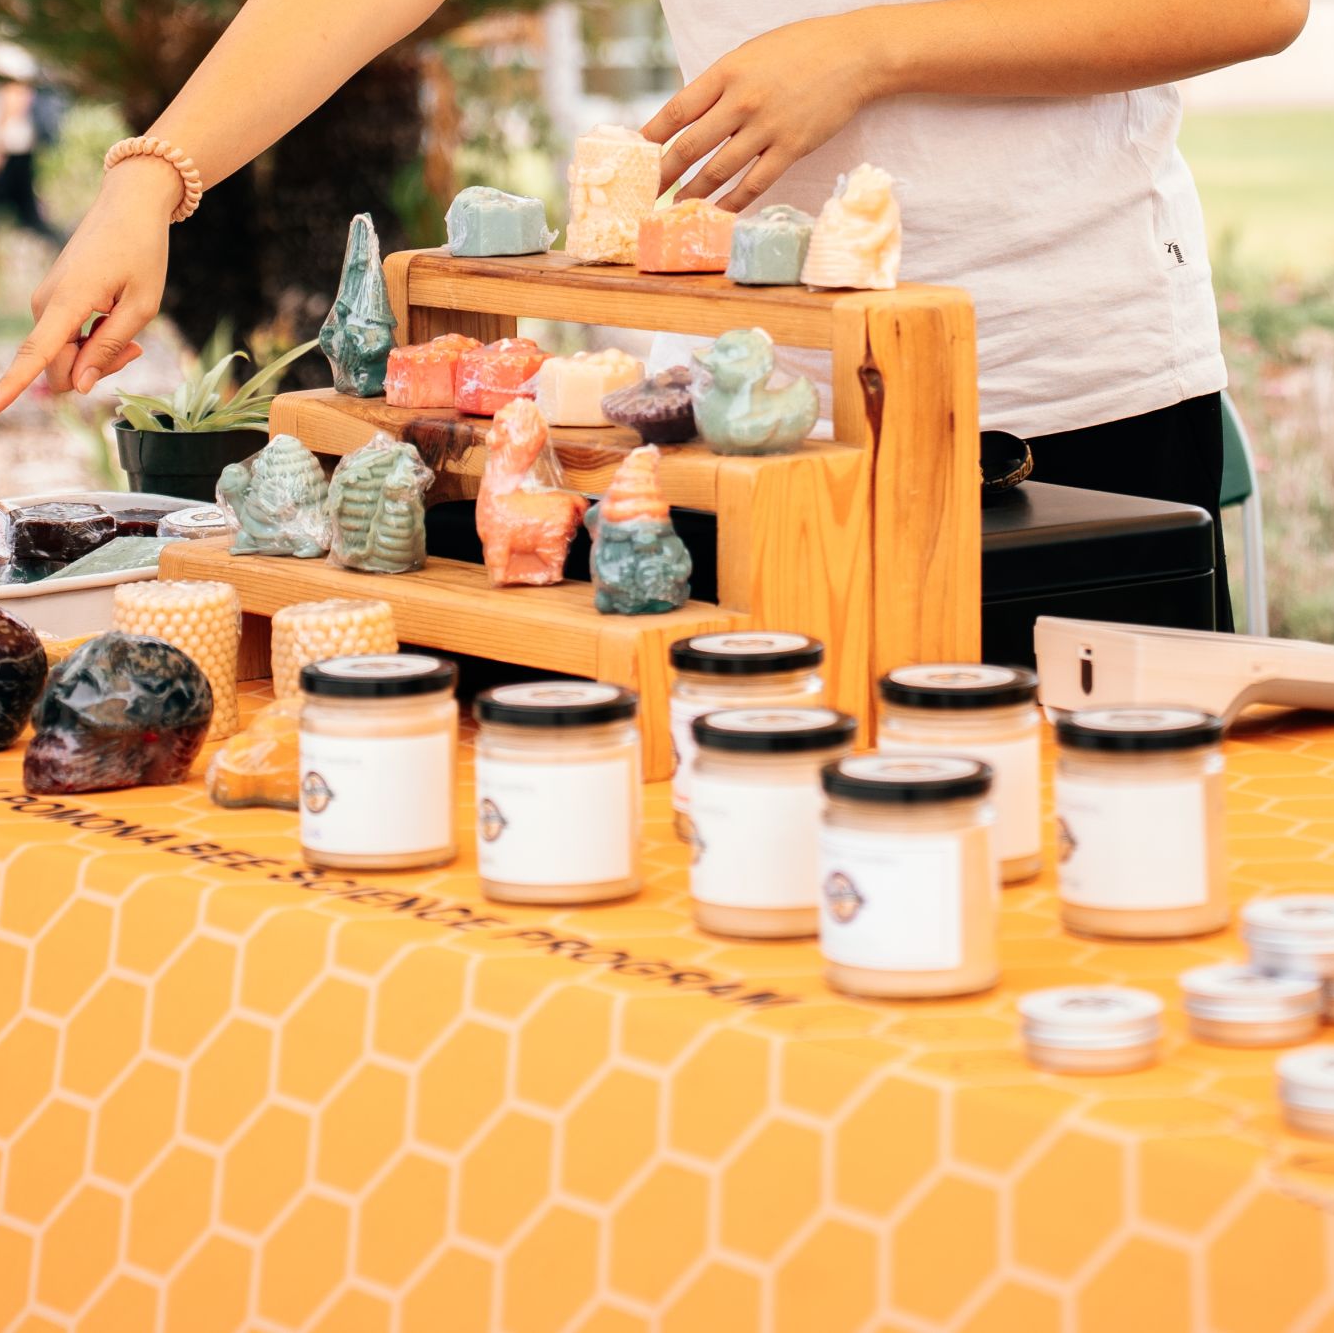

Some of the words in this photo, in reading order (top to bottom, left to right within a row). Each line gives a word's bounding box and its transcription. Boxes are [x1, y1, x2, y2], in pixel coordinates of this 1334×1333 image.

[161, 842, 286, 872] BEE
[268, 867, 510, 931] SCIENCE
[489, 930, 801, 1010] PROGRAM
